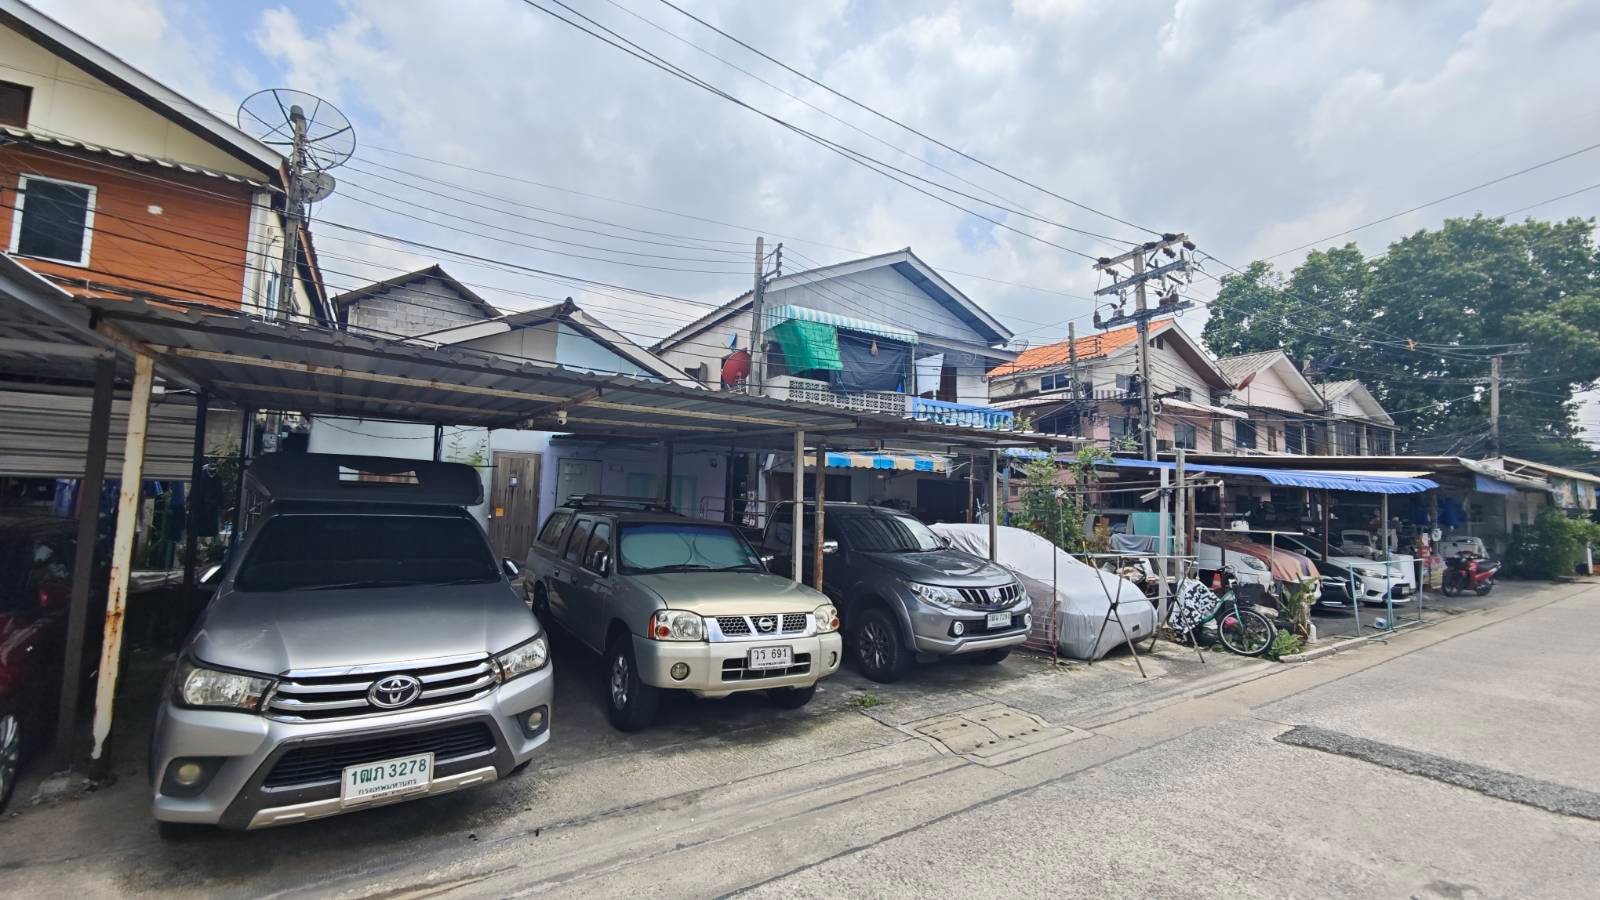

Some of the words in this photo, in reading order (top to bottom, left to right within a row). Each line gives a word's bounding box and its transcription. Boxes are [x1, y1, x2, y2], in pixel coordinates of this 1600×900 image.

[771, 648, 786, 659] 691
[388, 758, 427, 778] 3278
[358, 779, 417, 795] กรงเทพมหานคร
